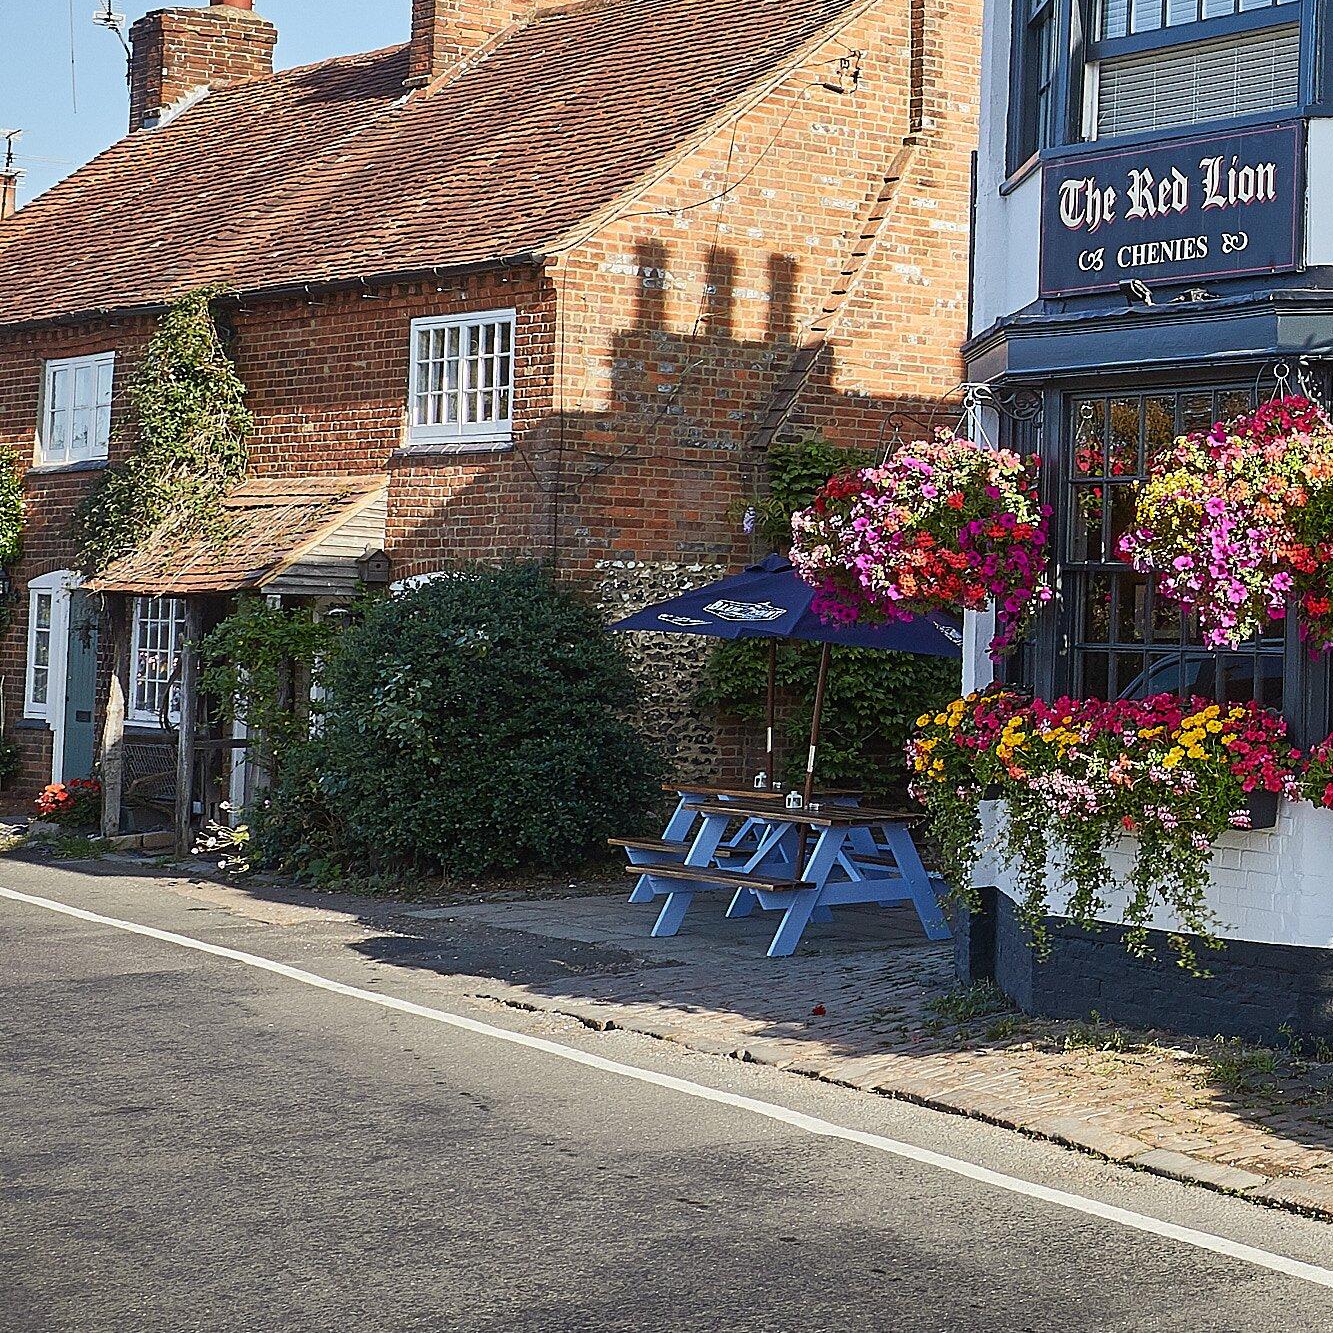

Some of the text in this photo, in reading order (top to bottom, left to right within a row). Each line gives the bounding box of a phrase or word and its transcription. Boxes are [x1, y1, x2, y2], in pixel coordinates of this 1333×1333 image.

[1058, 155, 1278, 233] The Red Lion
[1117, 235, 1208, 268] CHENIES
